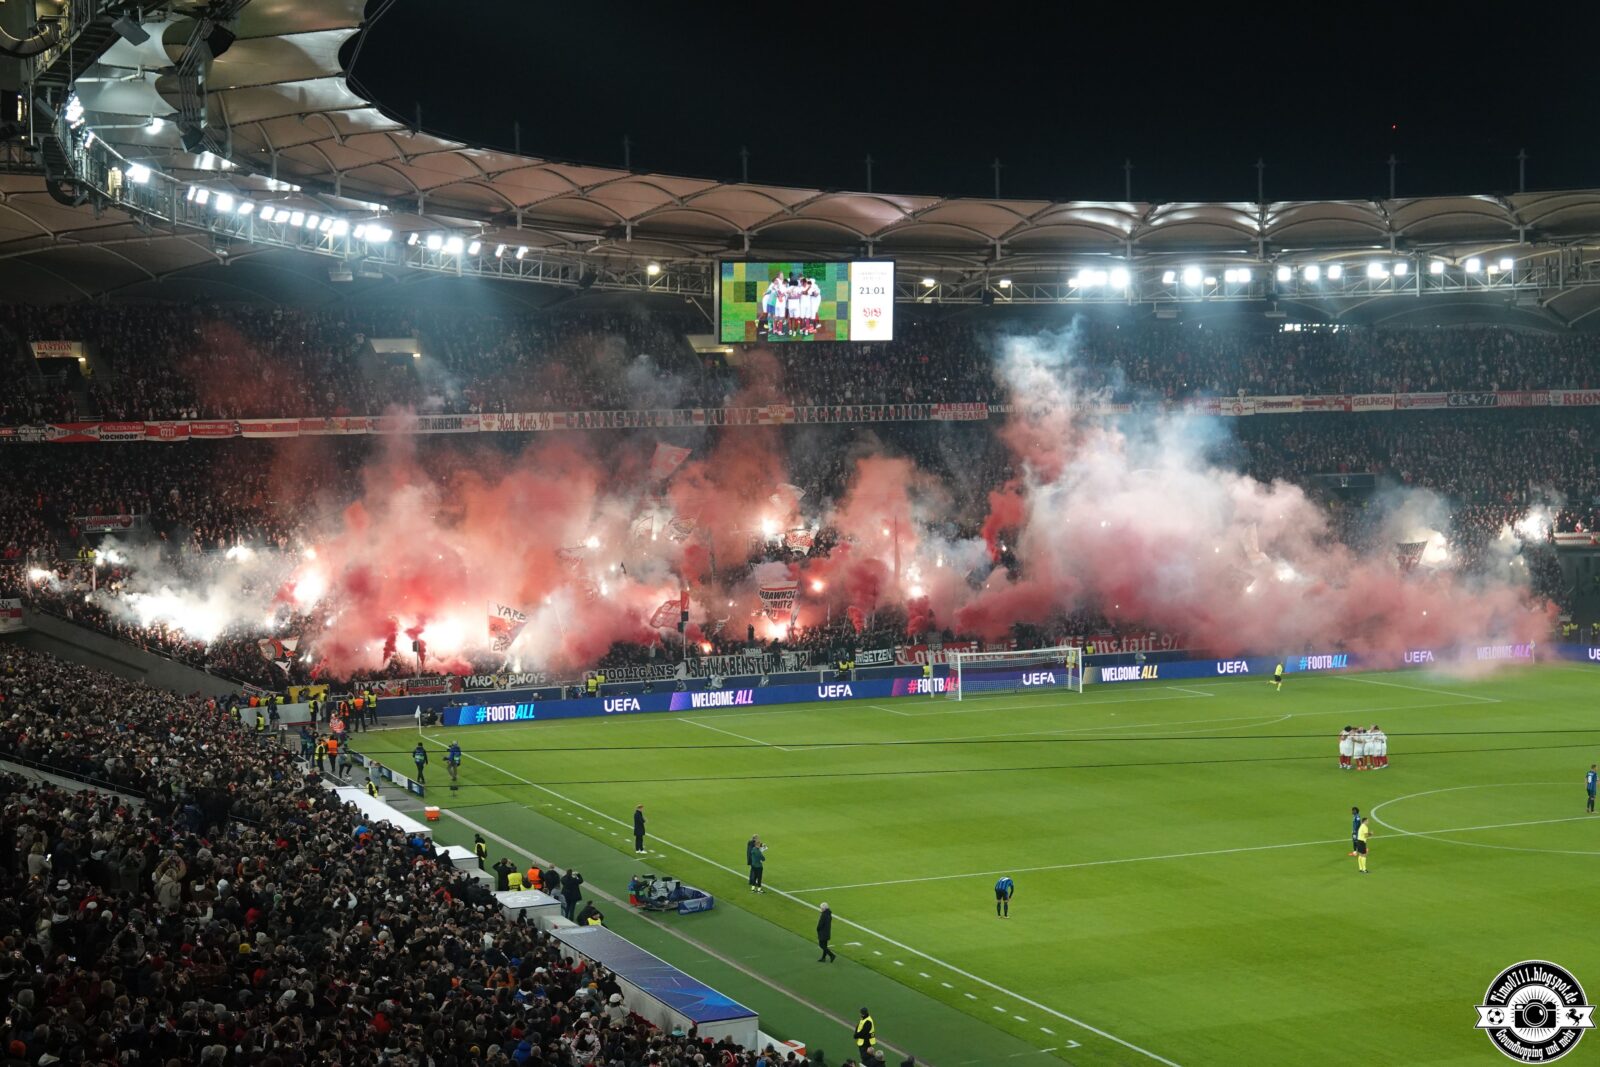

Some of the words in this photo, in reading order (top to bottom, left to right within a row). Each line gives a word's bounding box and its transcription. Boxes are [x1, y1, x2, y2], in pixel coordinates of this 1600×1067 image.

[859, 286, 886, 295] 21:01
[703, 407, 759, 426] KURVE
[793, 404, 933, 423] NECKARSTADION
[497, 414, 515, 431] Red
[496, 603, 527, 621] YARD
[1298, 654, 1348, 670] #FOOTBALL
[1404, 650, 1434, 663] UEFA
[1101, 666, 1140, 682] WELCOME
[1141, 664, 1158, 680] ALL
[1217, 660, 1249, 674] UEFA
[463, 675, 493, 688] YARD
[1022, 672, 1056, 686] UEFA
[691, 690, 734, 708] WELCOME
[734, 689, 754, 705] ALL
[818, 684, 853, 698] UEFA
[475, 703, 535, 722] #FOOTBALL
[603, 697, 641, 713] UEFA
